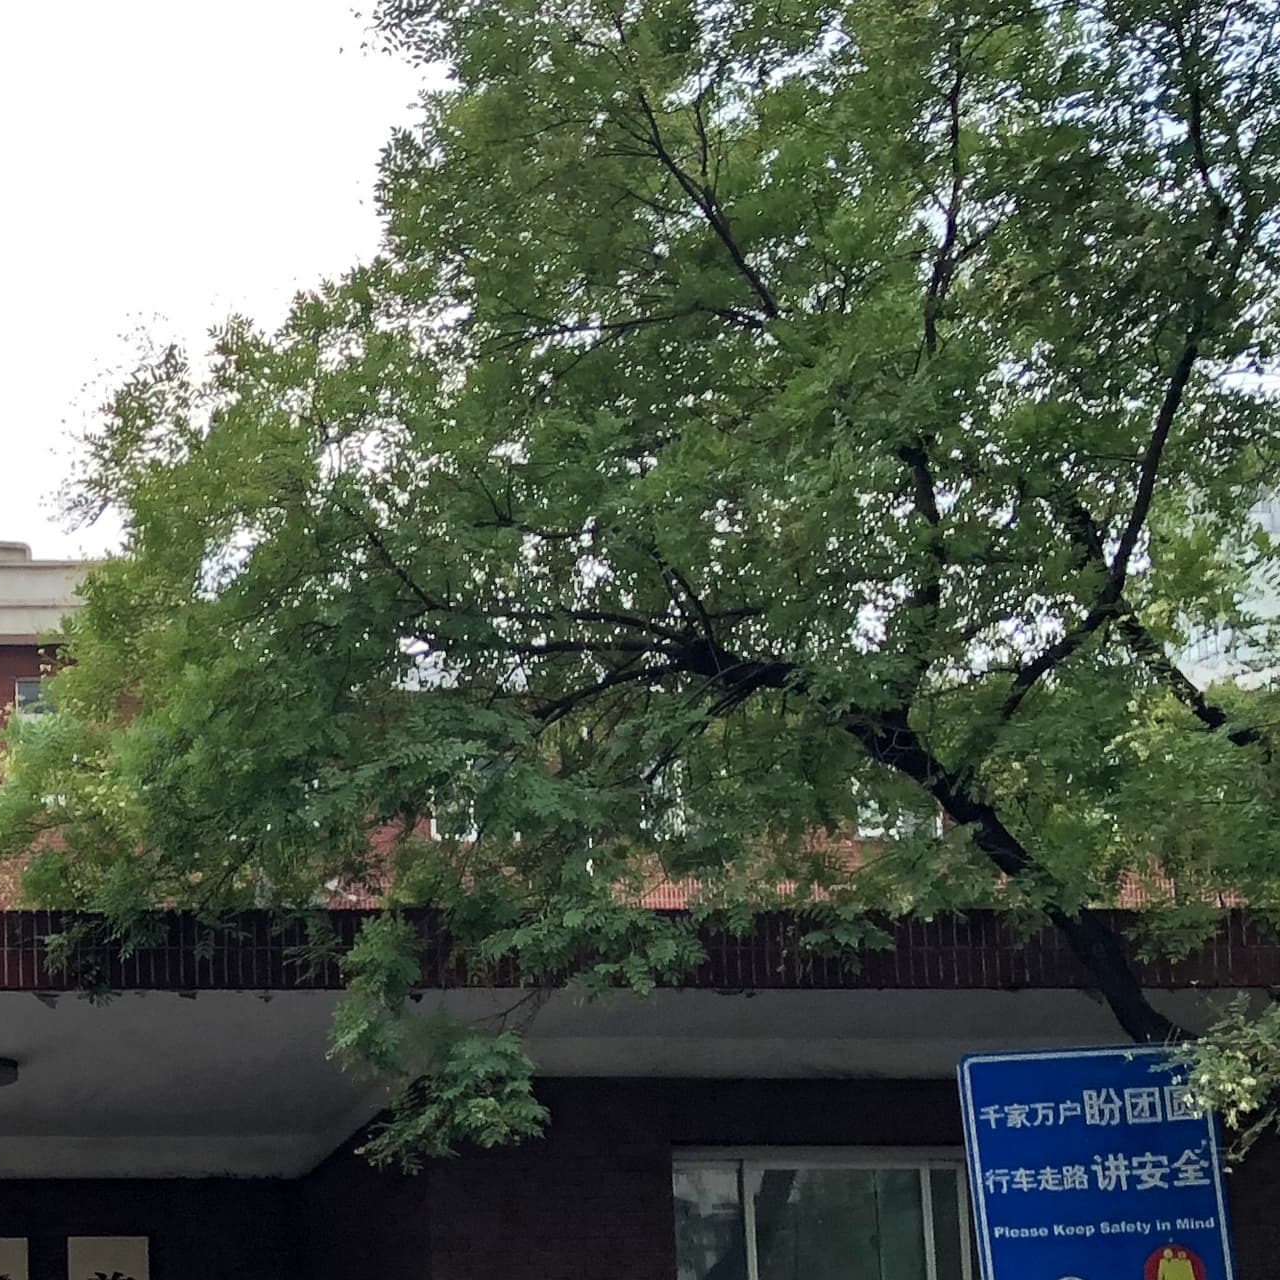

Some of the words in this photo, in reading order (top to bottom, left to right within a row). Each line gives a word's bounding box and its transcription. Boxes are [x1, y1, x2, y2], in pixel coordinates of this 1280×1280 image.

[985, 1149, 1211, 1194] 行车走路讲安全
[994, 1224, 1049, 1239] Please
[1053, 1223, 1095, 1238] Keep
[1100, 1220, 1152, 1236] Safety
[1176, 1216, 1216, 1231] Mind
